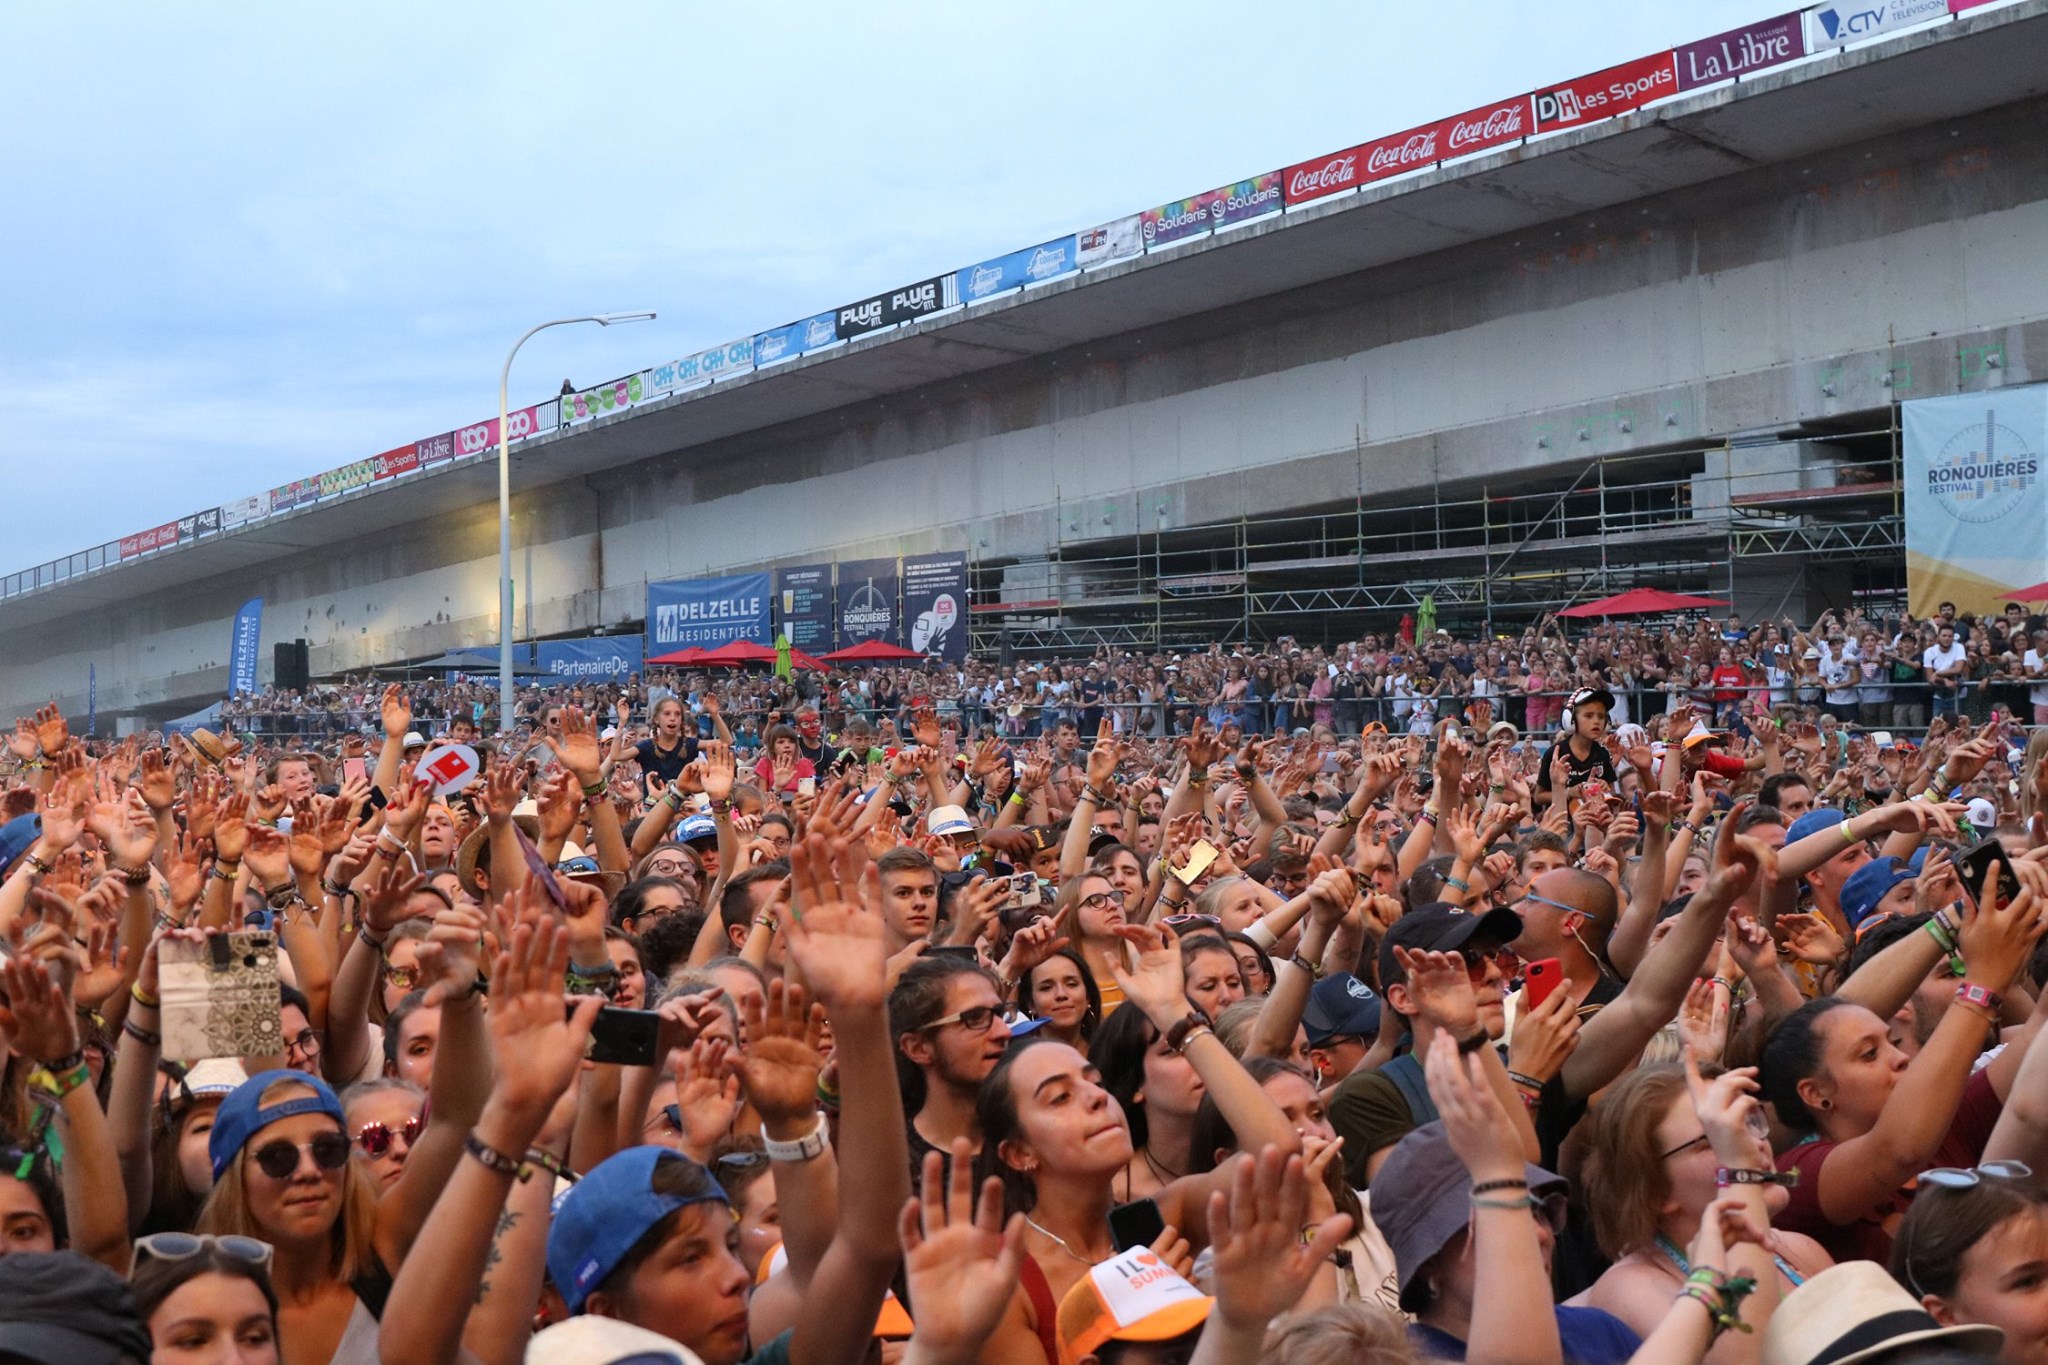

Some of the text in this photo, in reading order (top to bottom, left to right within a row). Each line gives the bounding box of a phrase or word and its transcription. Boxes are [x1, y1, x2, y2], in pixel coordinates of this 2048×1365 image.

[1688, 33, 1790, 81] La Libre
[1576, 90, 1608, 110] Les
[1609, 68, 1673, 99] Sports
[1449, 104, 1524, 149] Coca-Cola
[1367, 129, 1439, 173] Coca-Cola
[1290, 155, 1357, 197] Coca-Cola
[1227, 185, 1280, 211] Solidaris
[1157, 207, 1207, 232] Solidaris
[892, 284, 935, 310] PLUG
[840, 300, 882, 326] PLUG
[395, 452, 416, 468] Sports
[1928, 460, 2038, 484] RONQUIÈRES
[1929, 482, 1974, 495] FESTIVAL
[680, 597, 760, 620] DELZELLE
[844, 611, 891, 624] RONQUIÈRES
[237, 616, 249, 677] DELZELLE
[679, 626, 761, 642] RESIDENTIELS
[550, 656, 629, 676] #PartenaireDe
